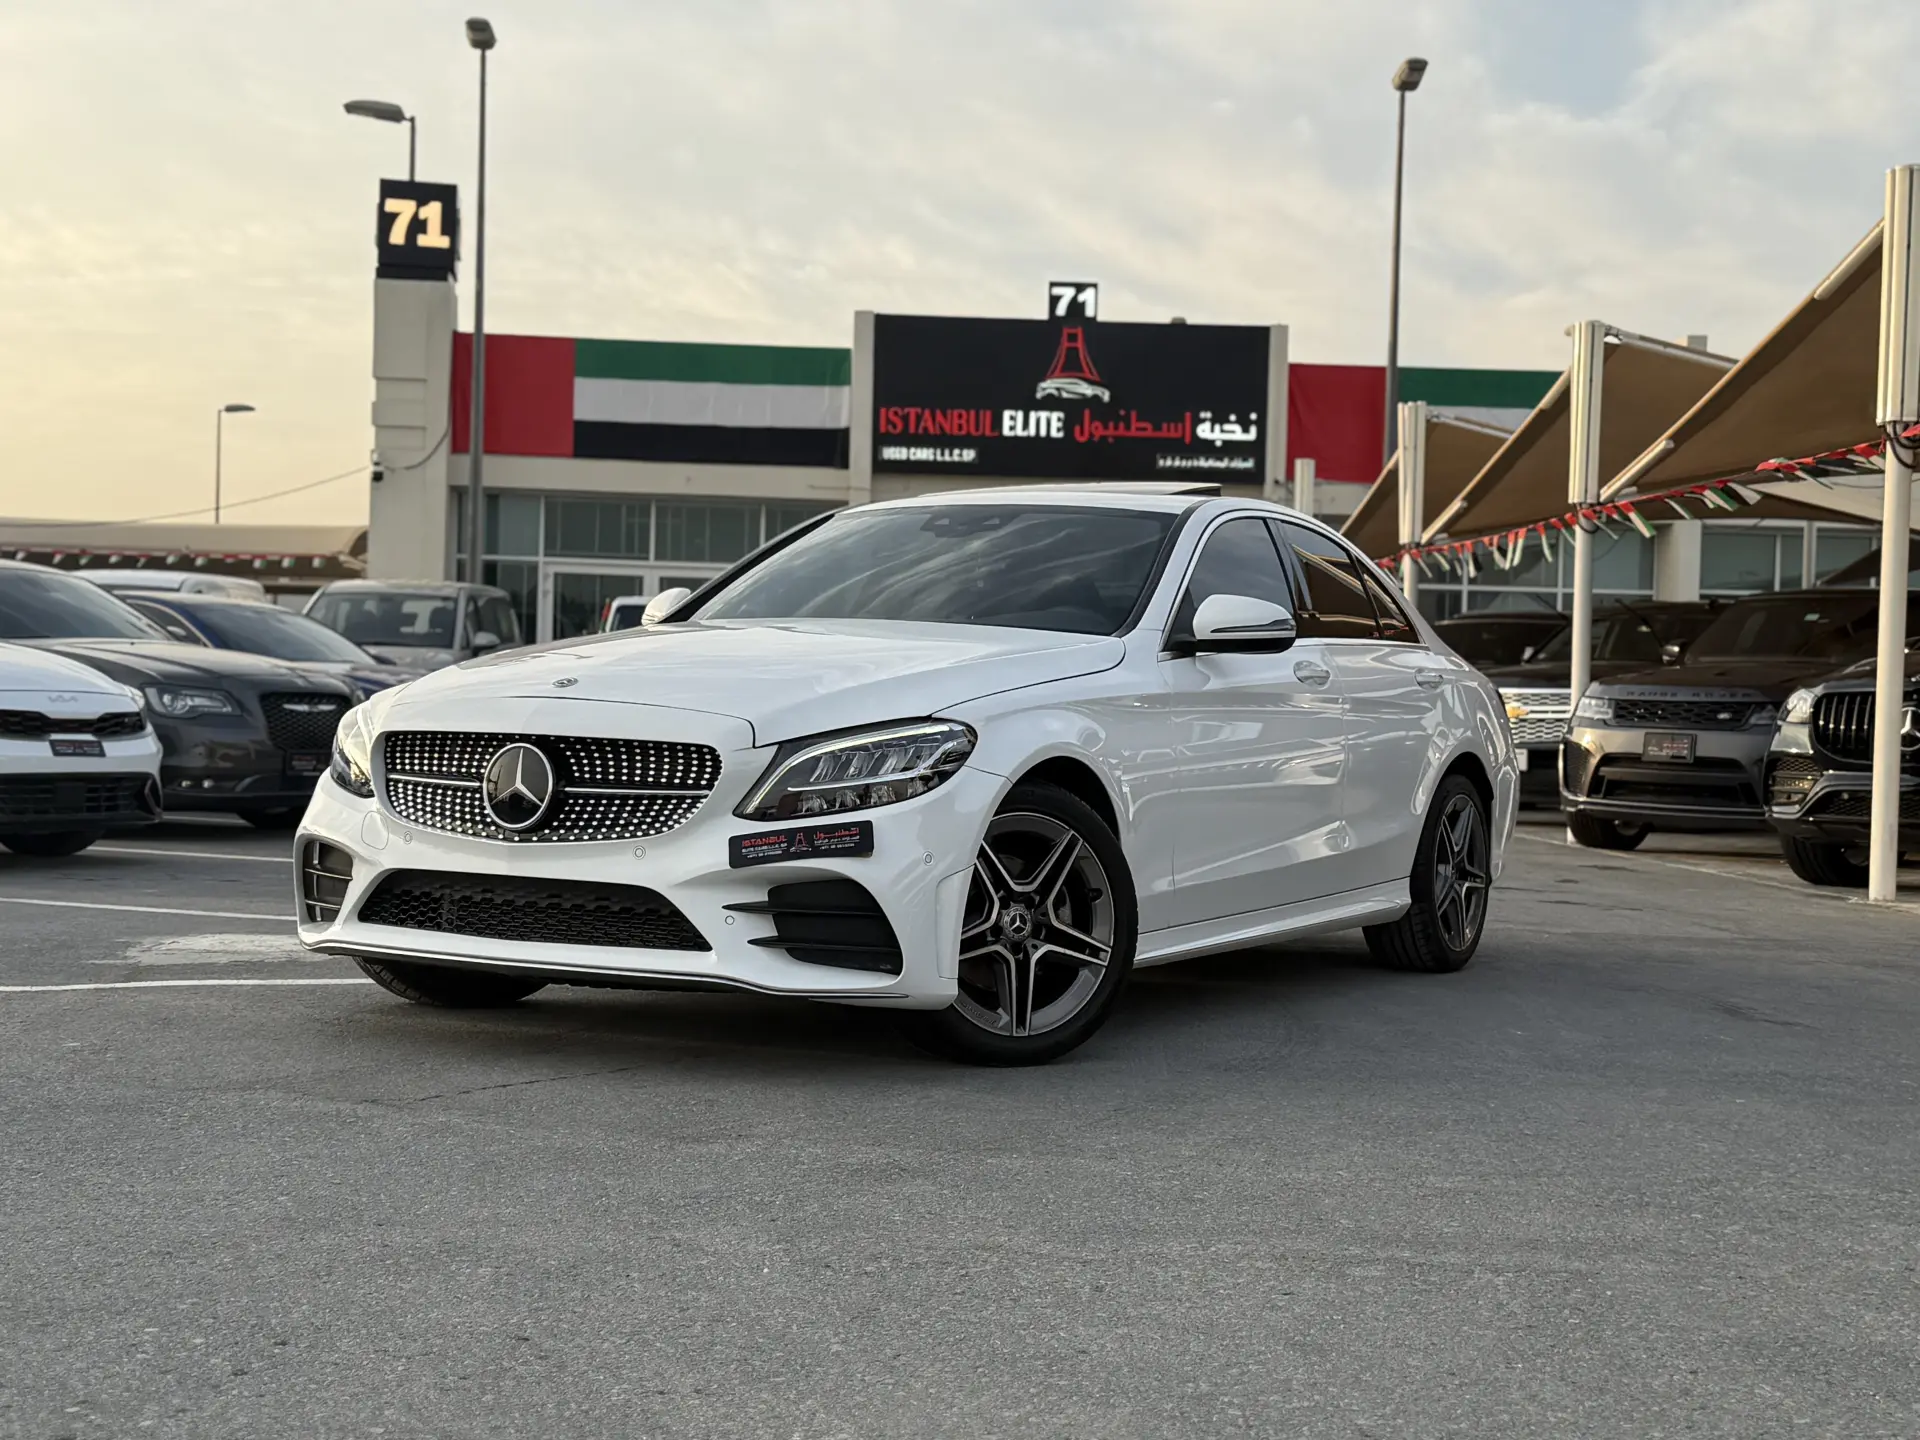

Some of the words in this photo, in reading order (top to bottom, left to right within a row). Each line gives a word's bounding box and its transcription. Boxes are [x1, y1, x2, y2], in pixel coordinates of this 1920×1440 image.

[384, 198, 451, 248] 71
[1051, 286, 1097, 318] 71
[879, 406, 999, 437] ISTANBUL
[1002, 409, 1065, 438] ELITE
[1196, 411, 1258, 447] نخبة
[742, 835, 788, 847] ISTANBUL
